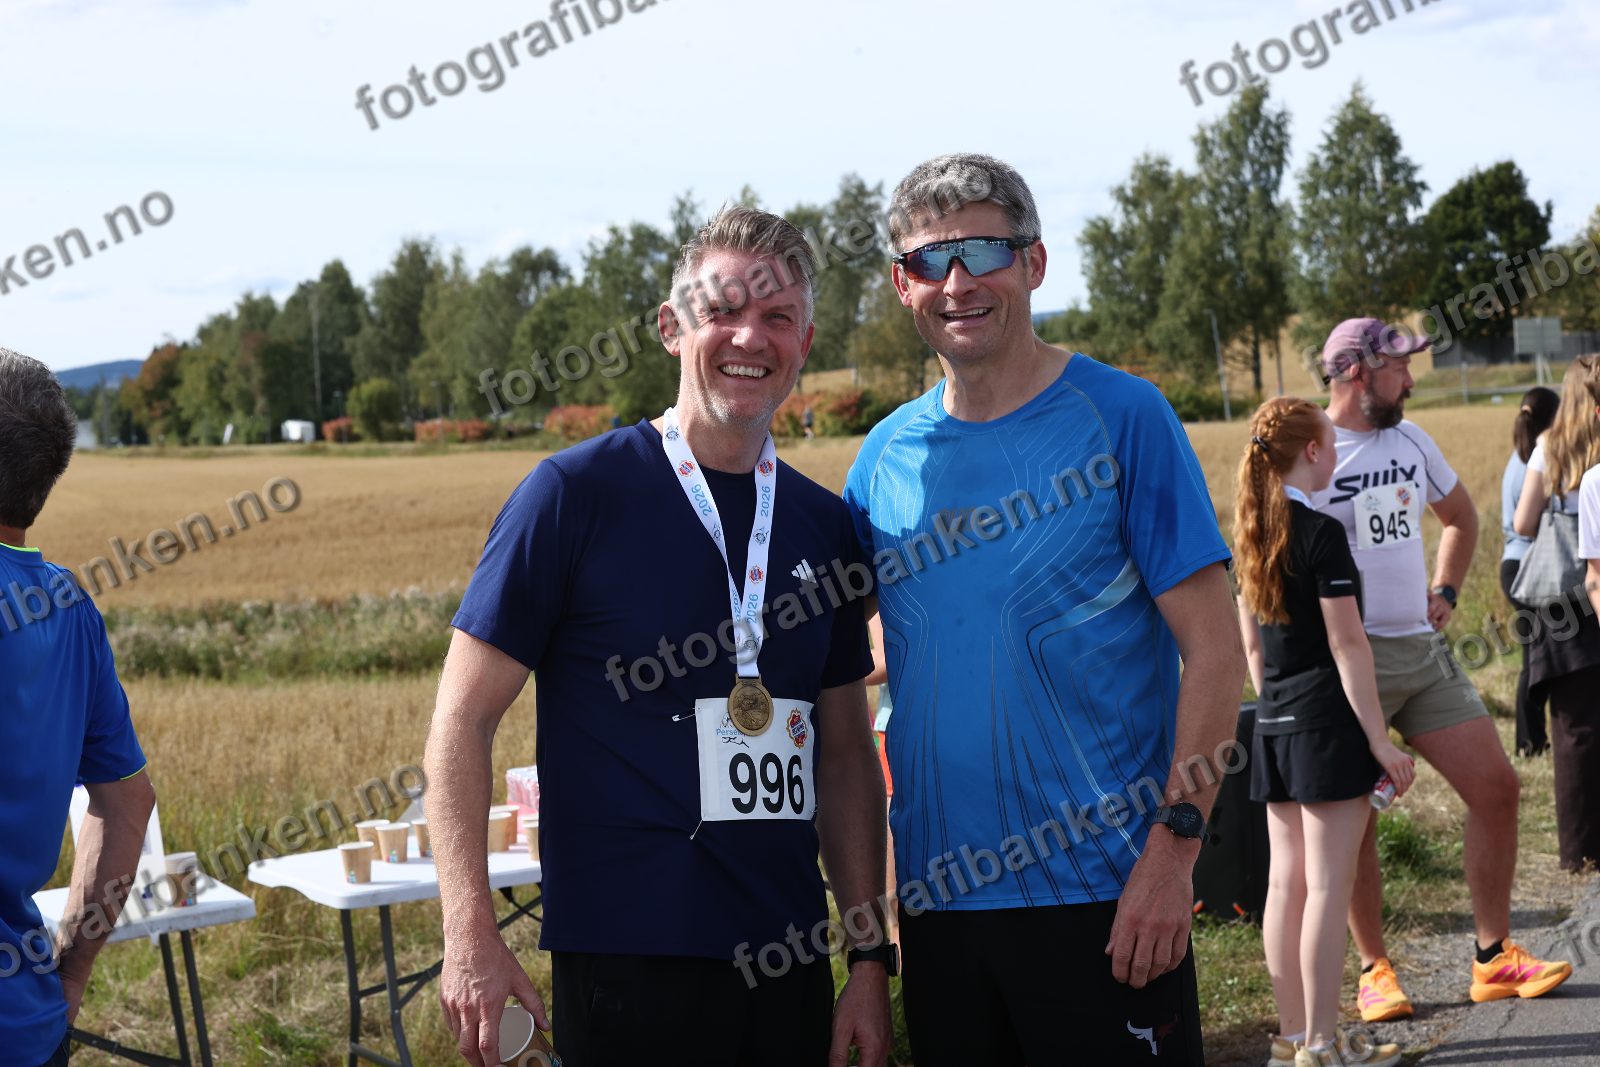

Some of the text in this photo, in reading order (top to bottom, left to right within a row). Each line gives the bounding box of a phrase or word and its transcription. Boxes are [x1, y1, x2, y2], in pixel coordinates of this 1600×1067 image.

[690, 484, 713, 516] 2026
[760, 485, 771, 518] 2026
[1369, 510, 1411, 545] 945
[746, 593, 759, 624] 2026
[728, 752, 805, 815] 996
